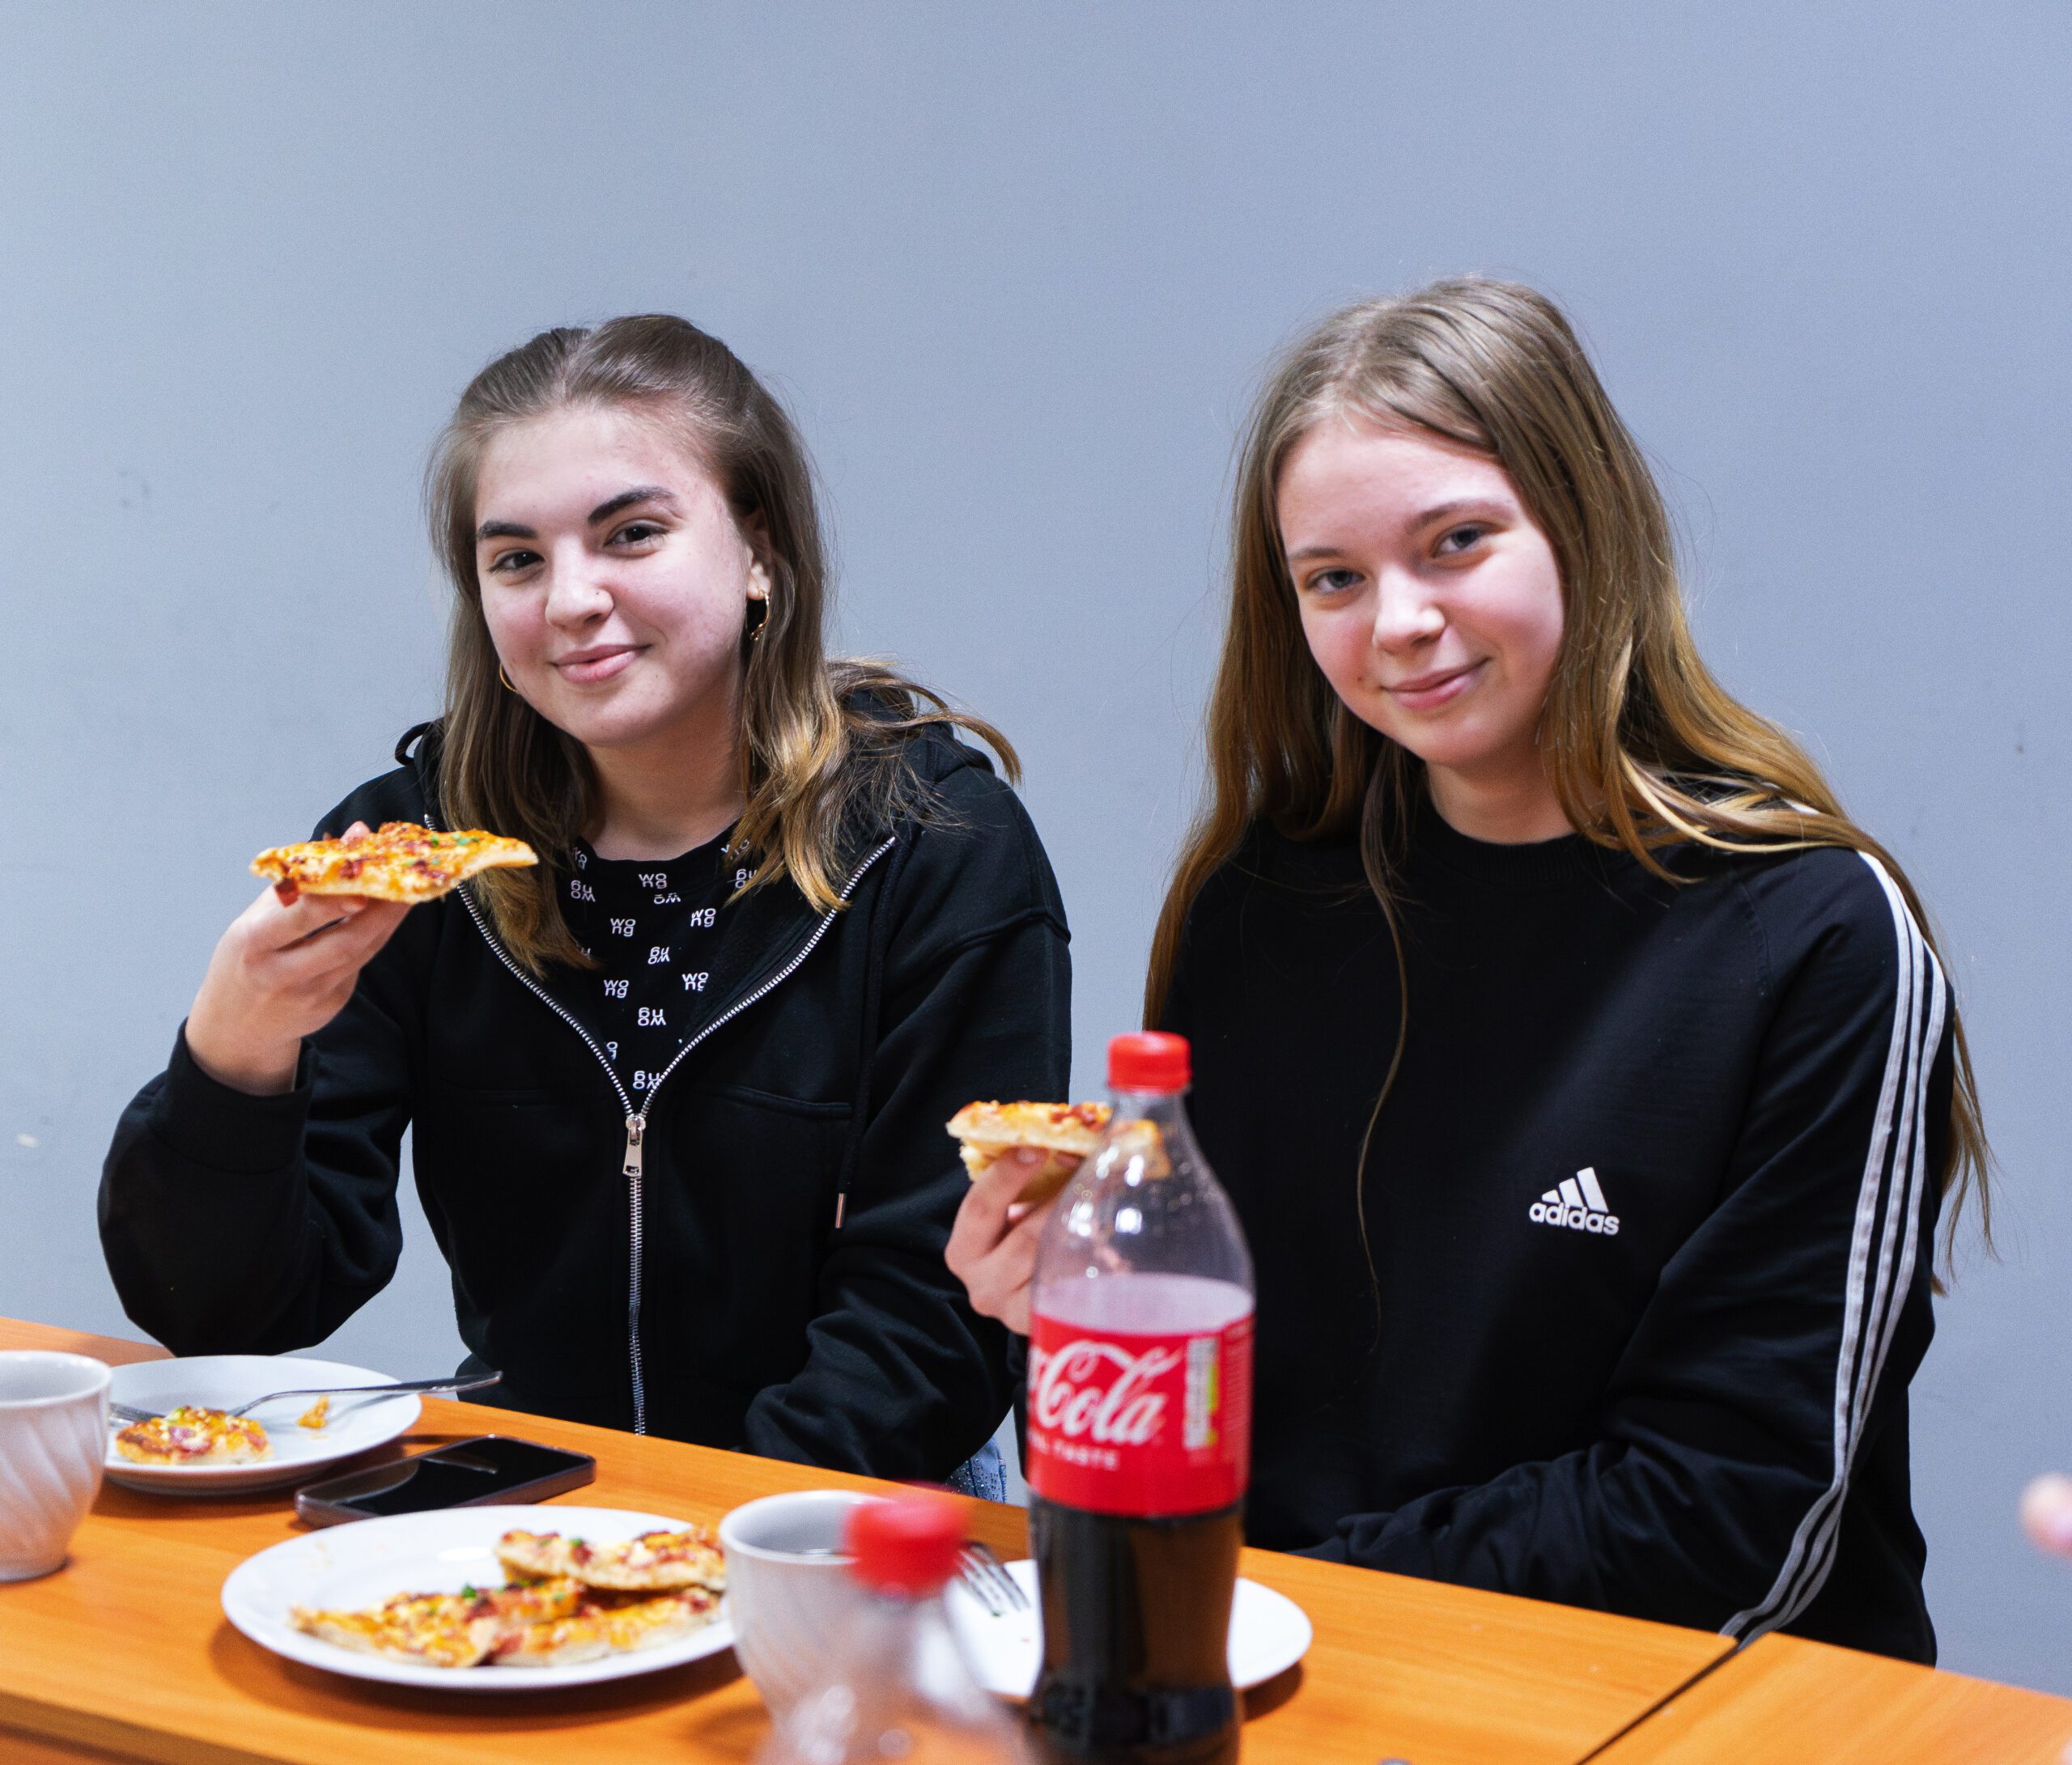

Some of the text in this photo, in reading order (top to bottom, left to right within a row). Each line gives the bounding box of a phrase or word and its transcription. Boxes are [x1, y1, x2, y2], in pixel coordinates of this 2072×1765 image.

[638, 873, 667, 881] wo
[643, 880, 668, 889] ng
[571, 890, 596, 902] wo
[691, 908, 716, 918] wo
[609, 918, 636, 927] wo
[690, 916, 715, 927] ng
[611, 926, 634, 937] ng
[681, 972, 709, 982] wo
[603, 979, 630, 988] wo
[605, 986, 627, 999] ng
[638, 1007, 664, 1019] ng
[637, 1016, 667, 1026] wo
[1529, 1202, 1620, 1236] adidas
